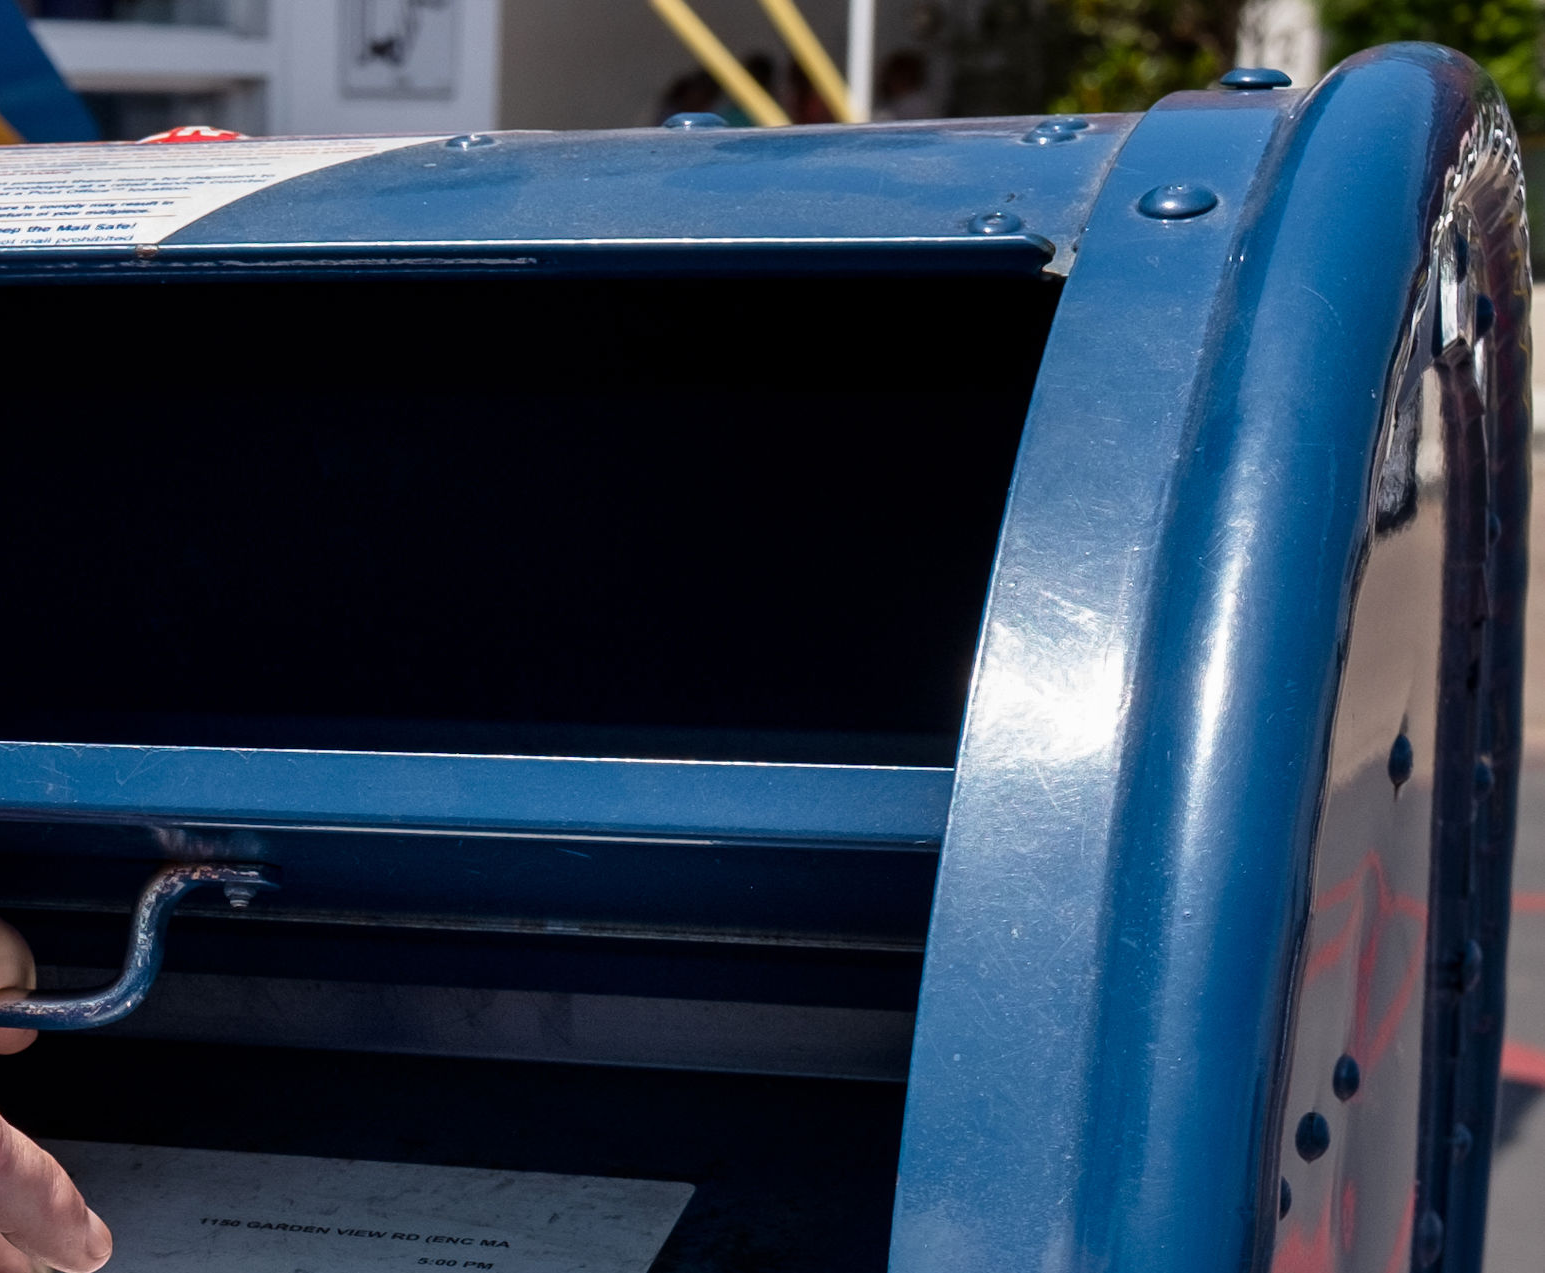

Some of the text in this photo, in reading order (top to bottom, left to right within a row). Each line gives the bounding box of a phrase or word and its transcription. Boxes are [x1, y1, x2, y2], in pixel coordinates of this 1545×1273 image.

[26, 225, 51, 233] the
[56, 224, 91, 232] Mail
[95, 222, 137, 231] Safe!
[20, 237, 51, 245] mail
[55, 235, 135, 245] prohibited
[246, 1219, 331, 1235] GARDEN
[336, 1227, 387, 1239] VIEW
[391, 1232, 419, 1242] RD
[425, 1234, 474, 1246] (ENC
[479, 1239, 511, 1249] MA
[417, 1257, 494, 1271] 5:00 PM
